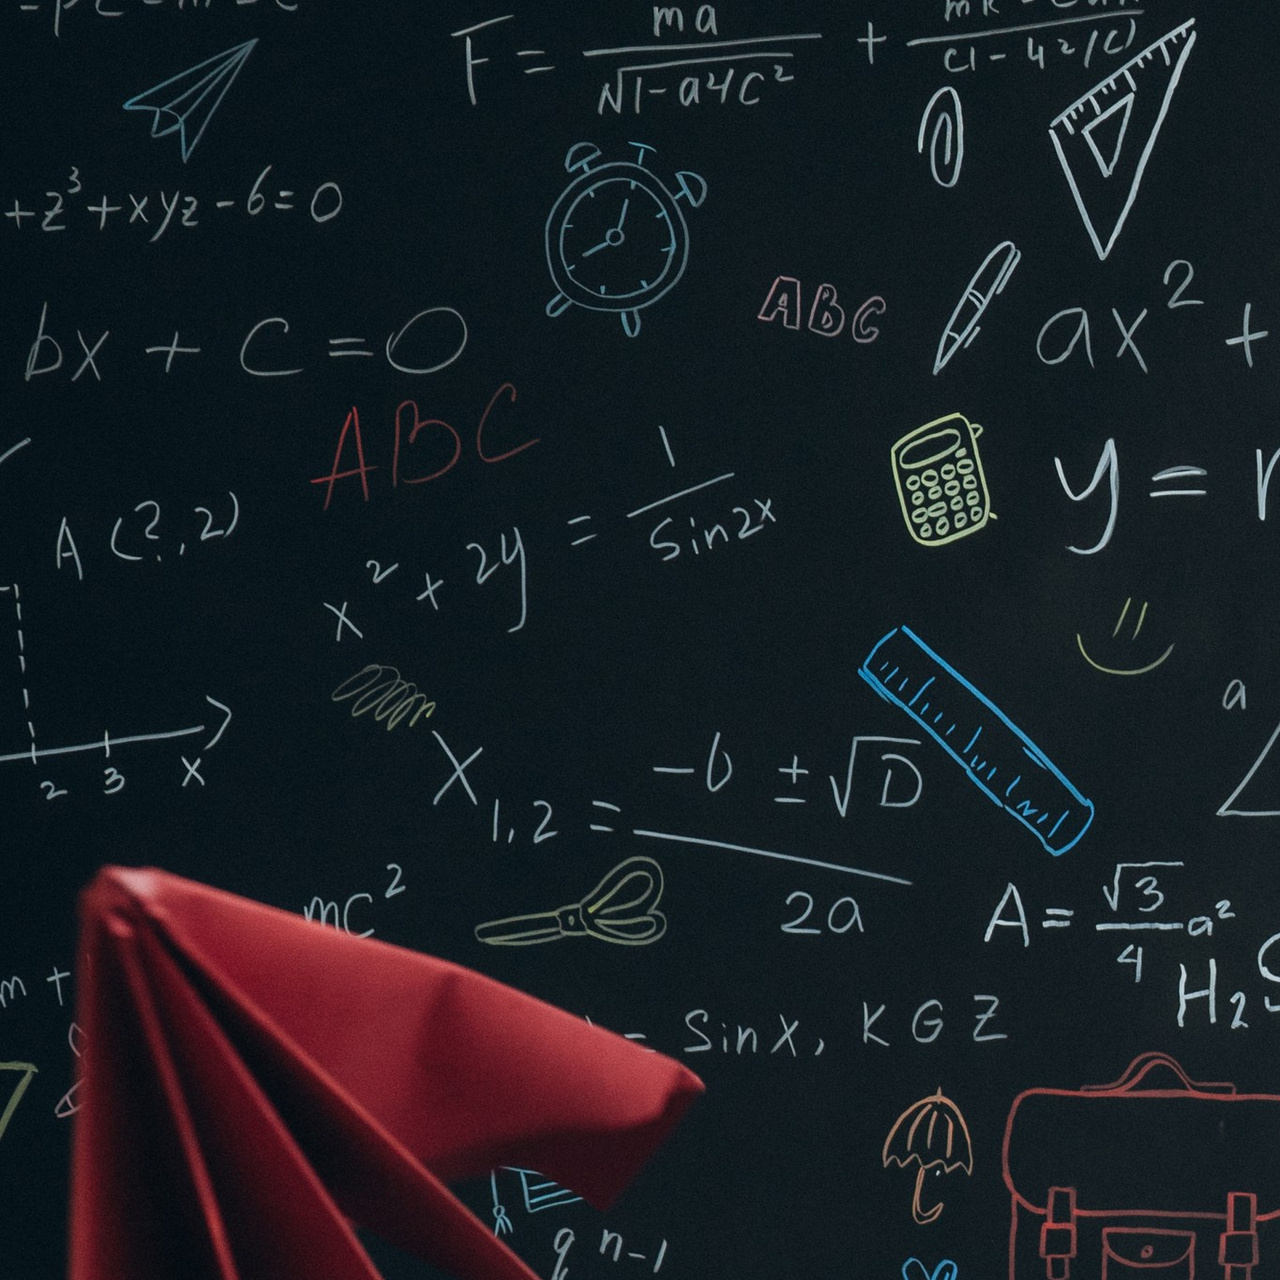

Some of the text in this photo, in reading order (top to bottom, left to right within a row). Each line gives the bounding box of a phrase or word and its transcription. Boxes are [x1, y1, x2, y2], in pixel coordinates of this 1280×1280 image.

[652, 3, 719, 38] ma
[450, 14, 514, 106] F
[756, 274, 887, 345] ABC
[309, 382, 541, 510] ABC
[1221, 678, 1247, 711] a
[39, 779, 69, 801] 2
[103, 766, 127, 796] 3
[779, 889, 865, 936] 2a
